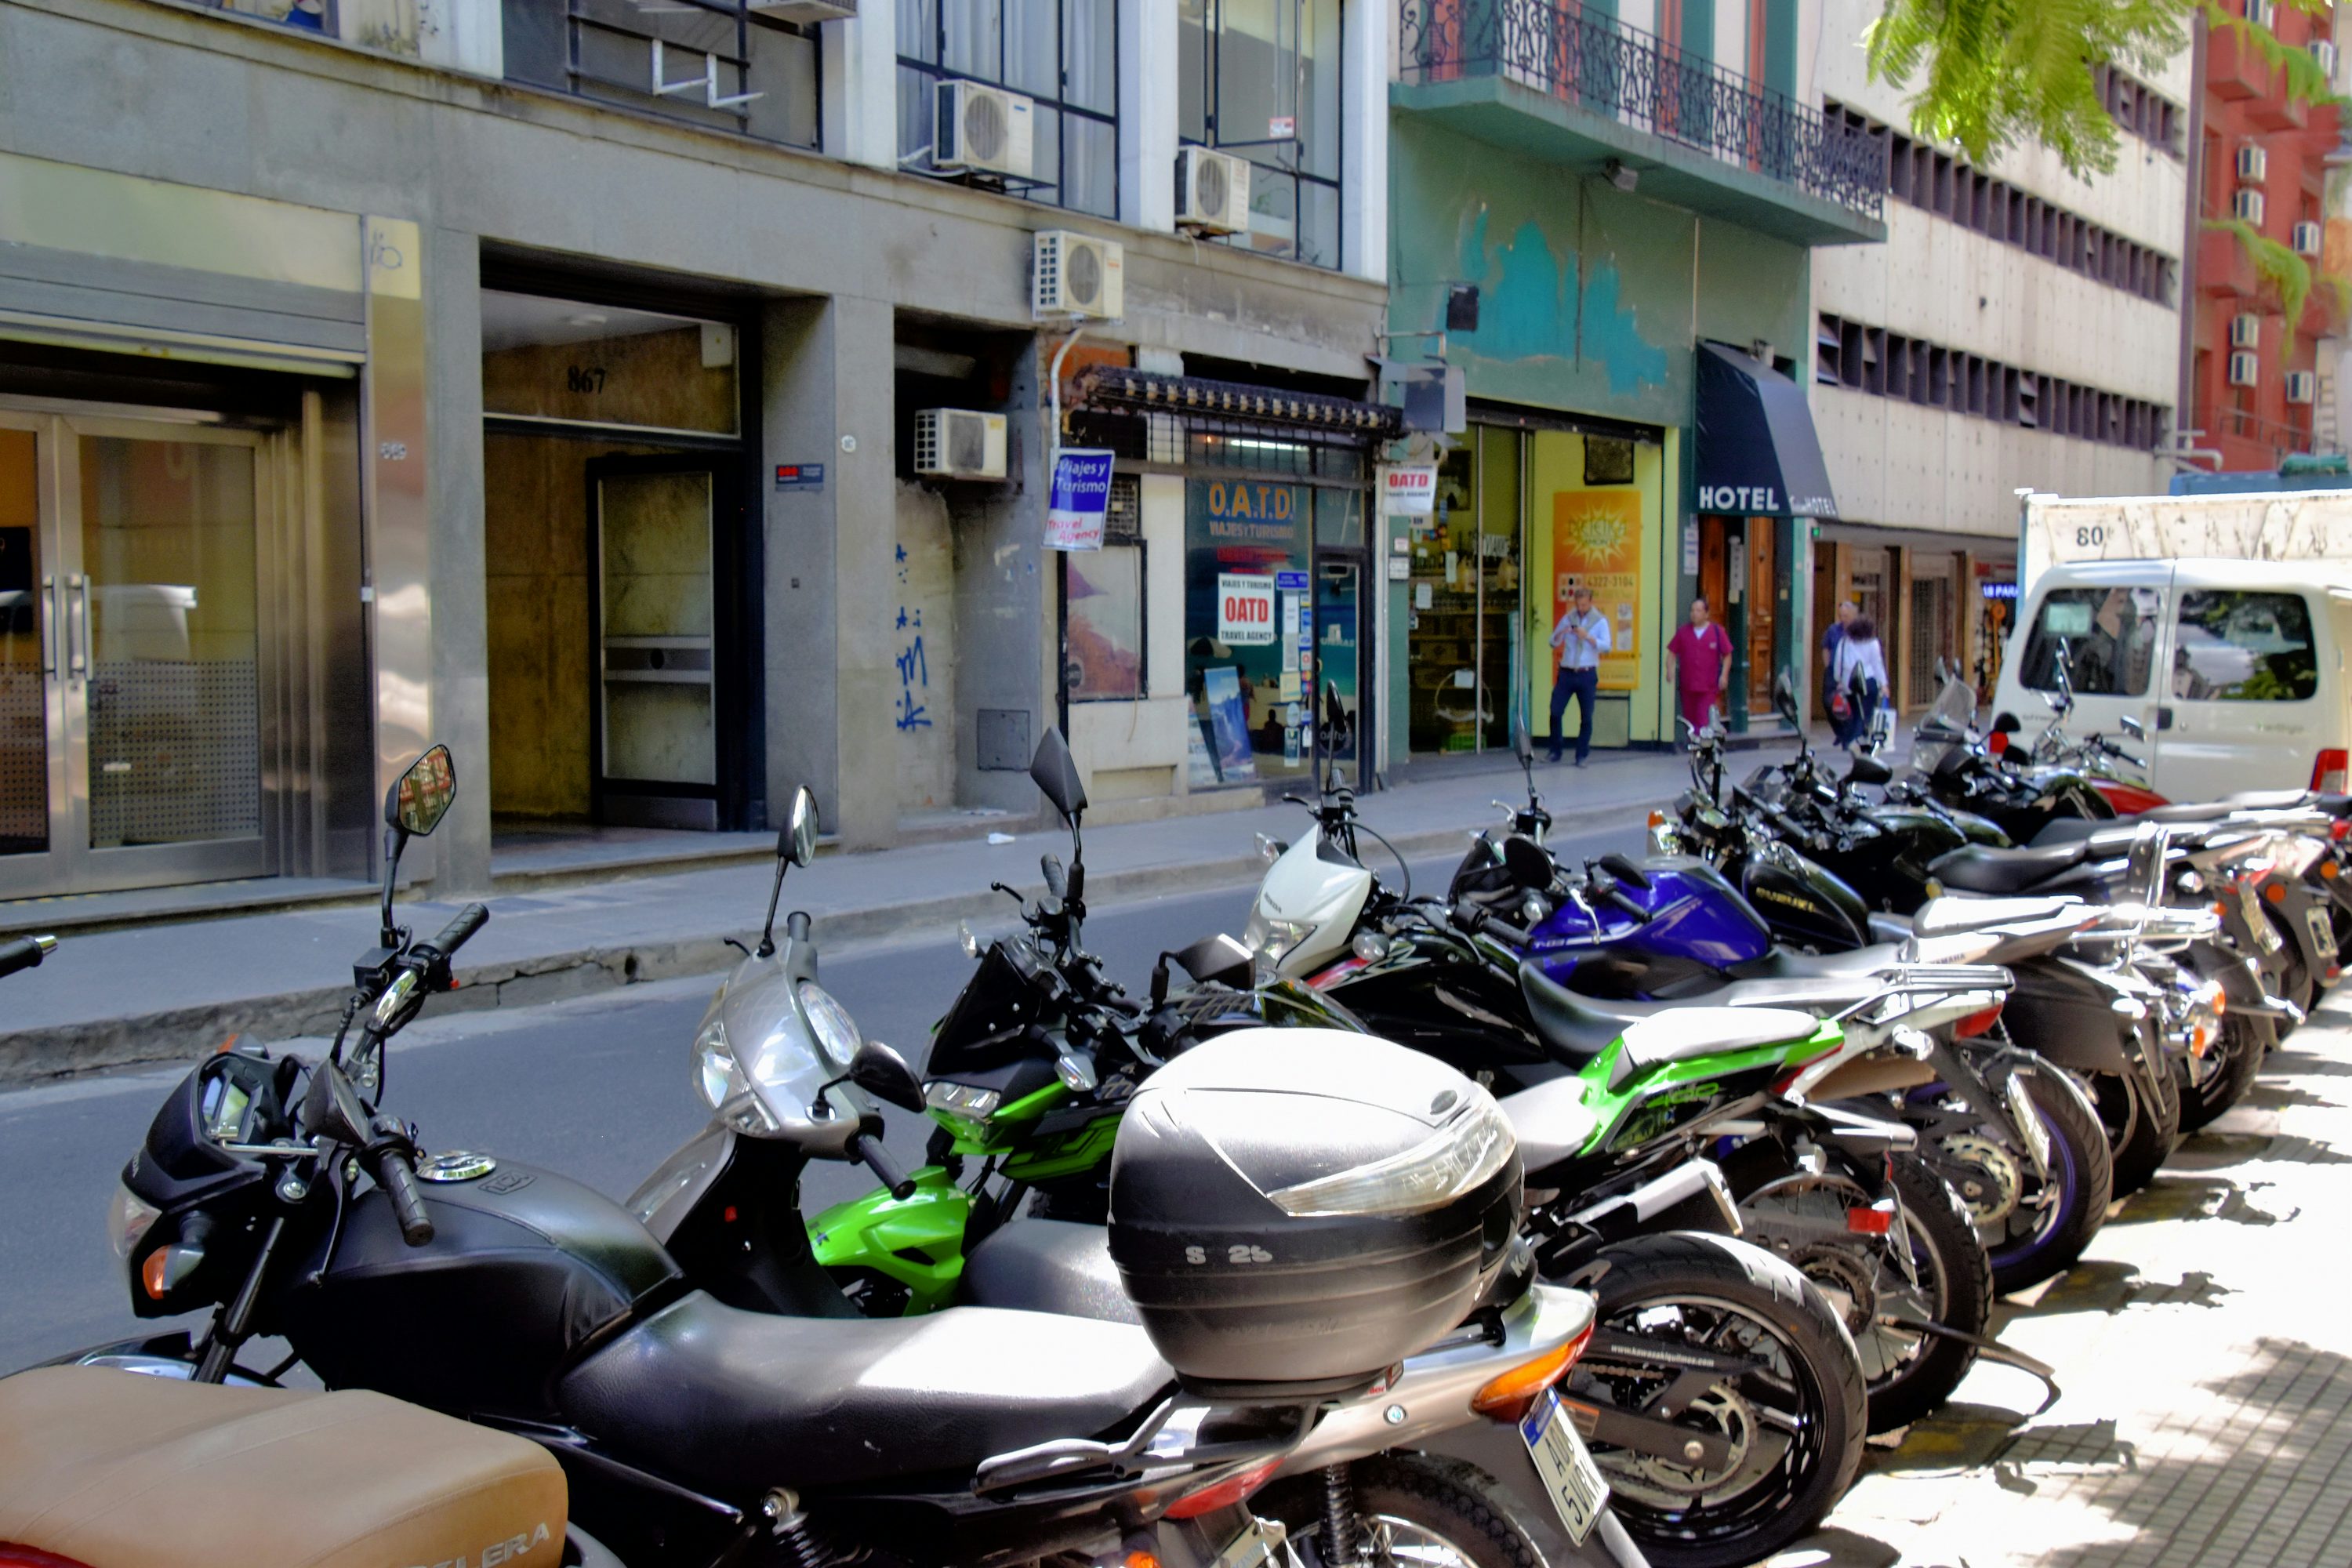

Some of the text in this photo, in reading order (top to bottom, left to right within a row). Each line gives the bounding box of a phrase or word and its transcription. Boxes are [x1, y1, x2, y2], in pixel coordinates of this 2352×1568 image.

[568, 365, 605, 394] 867
[1059, 459, 1107, 477] Viajes y
[1056, 477, 1107, 493] Turismo
[1389, 473, 1428, 488] OATD
[1209, 482, 1294, 521] O.A.T.D.
[1699, 486, 1779, 510] HOTEL
[1048, 517, 1083, 529] Travel
[1209, 521, 1243, 537] VIAJES
[1250, 523, 1294, 539] TURISMO
[1059, 528, 1099, 543] Agency
[2077, 526, 2103, 546] 80
[1221, 579, 1241, 588] VIAJES
[1247, 580, 1272, 589] TURISMO
[1225, 596, 1269, 623] OATD
[1221, 630, 1272, 641] TRAVEL AGENCY
[1185, 1245, 1206, 1265] S
